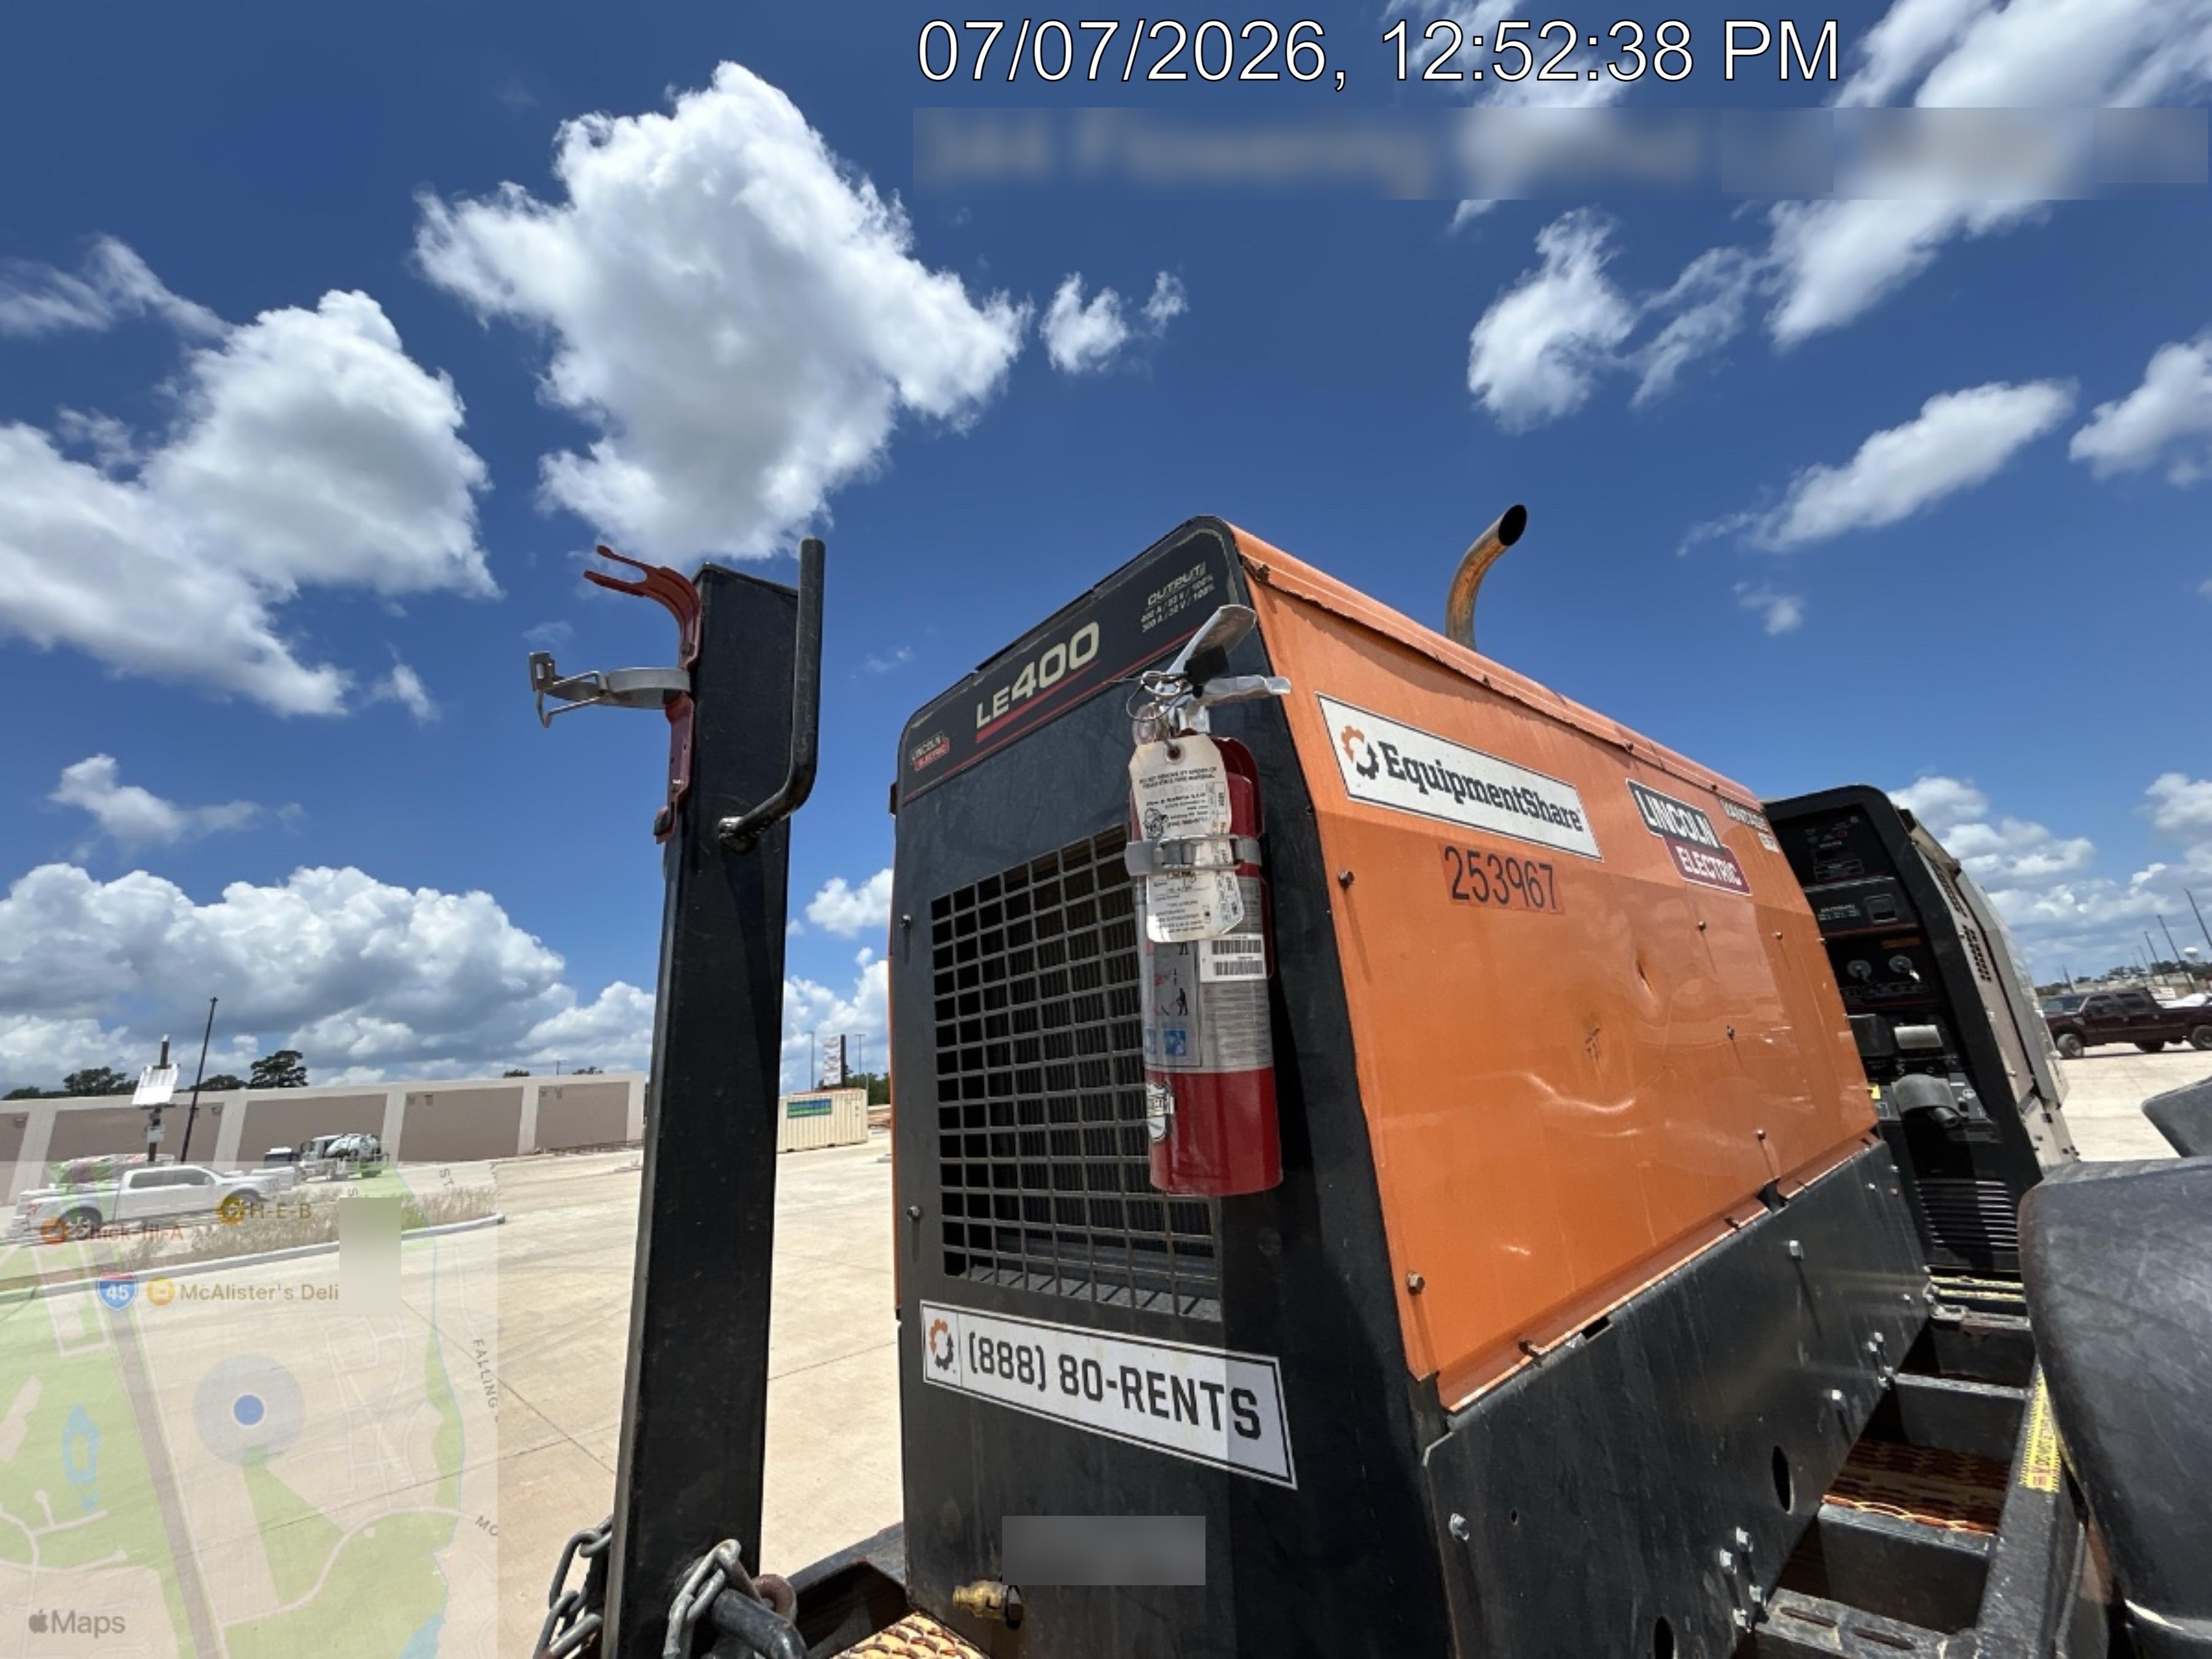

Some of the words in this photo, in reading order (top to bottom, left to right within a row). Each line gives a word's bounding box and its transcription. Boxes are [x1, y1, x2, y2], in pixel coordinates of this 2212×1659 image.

[976, 620, 1100, 729] LE400
[1377, 739, 1584, 833] EquipmentShare
[1634, 790, 1720, 849] LINCOLN
[1444, 845, 1556, 910] 253967
[1675, 844, 1743, 885] ELECTRIC
[968, 1331, 1046, 1391] (888)
[1058, 1354, 1262, 1440] 80-RENTS
